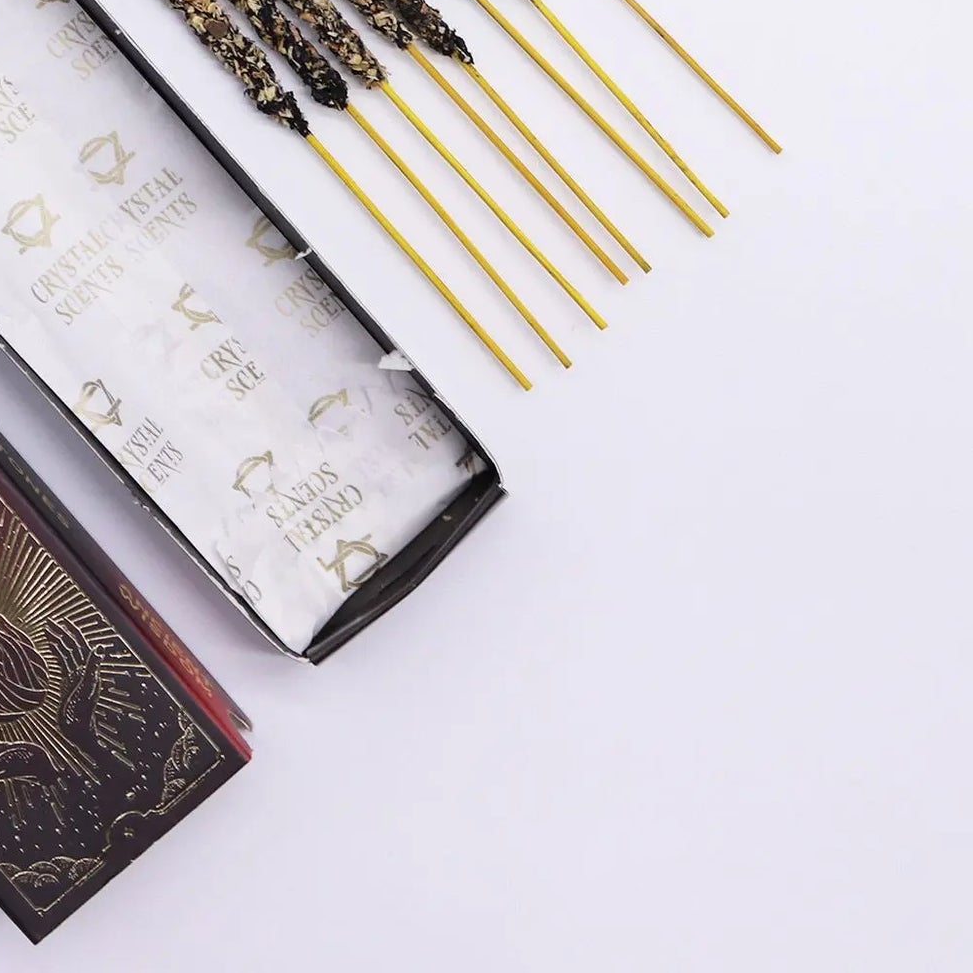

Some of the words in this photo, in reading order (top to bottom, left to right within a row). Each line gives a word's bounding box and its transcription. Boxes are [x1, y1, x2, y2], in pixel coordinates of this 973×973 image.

[30, 226, 109, 304] CRYSTAL
[54, 254, 125, 326] SCENTS
[266, 461, 339, 529] SCENTS
[283, 484, 363, 552] CRYSTAL
